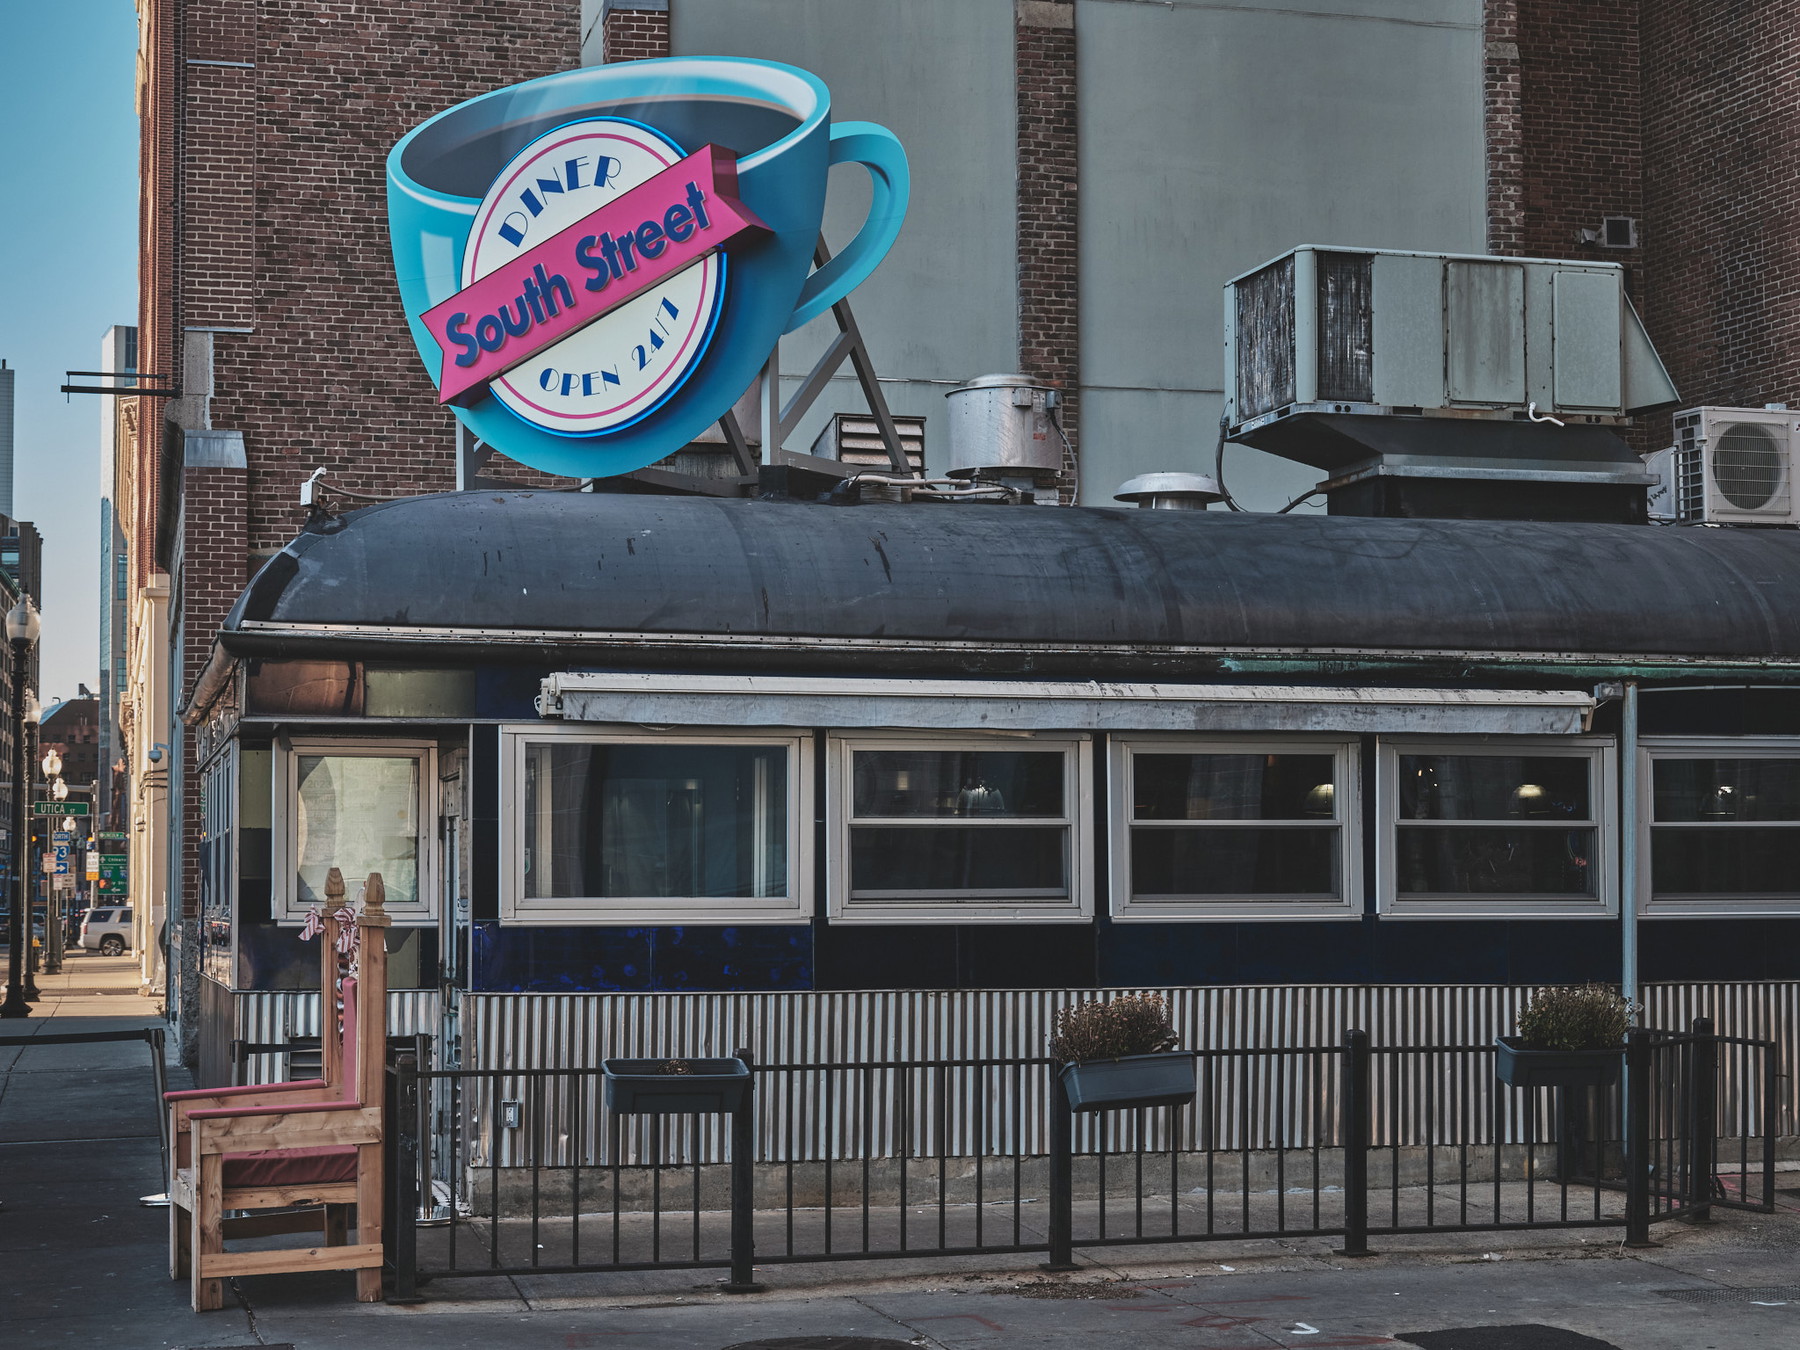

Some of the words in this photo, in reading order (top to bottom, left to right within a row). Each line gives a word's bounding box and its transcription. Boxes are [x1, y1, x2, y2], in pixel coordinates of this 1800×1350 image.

[498, 155, 622, 248] DINER
[445, 262, 576, 368] South
[575, 180, 711, 292] Street
[539, 364, 621, 397] OPEN
[631, 296, 680, 371] 24/7
[40, 804, 65, 814] UTICA
